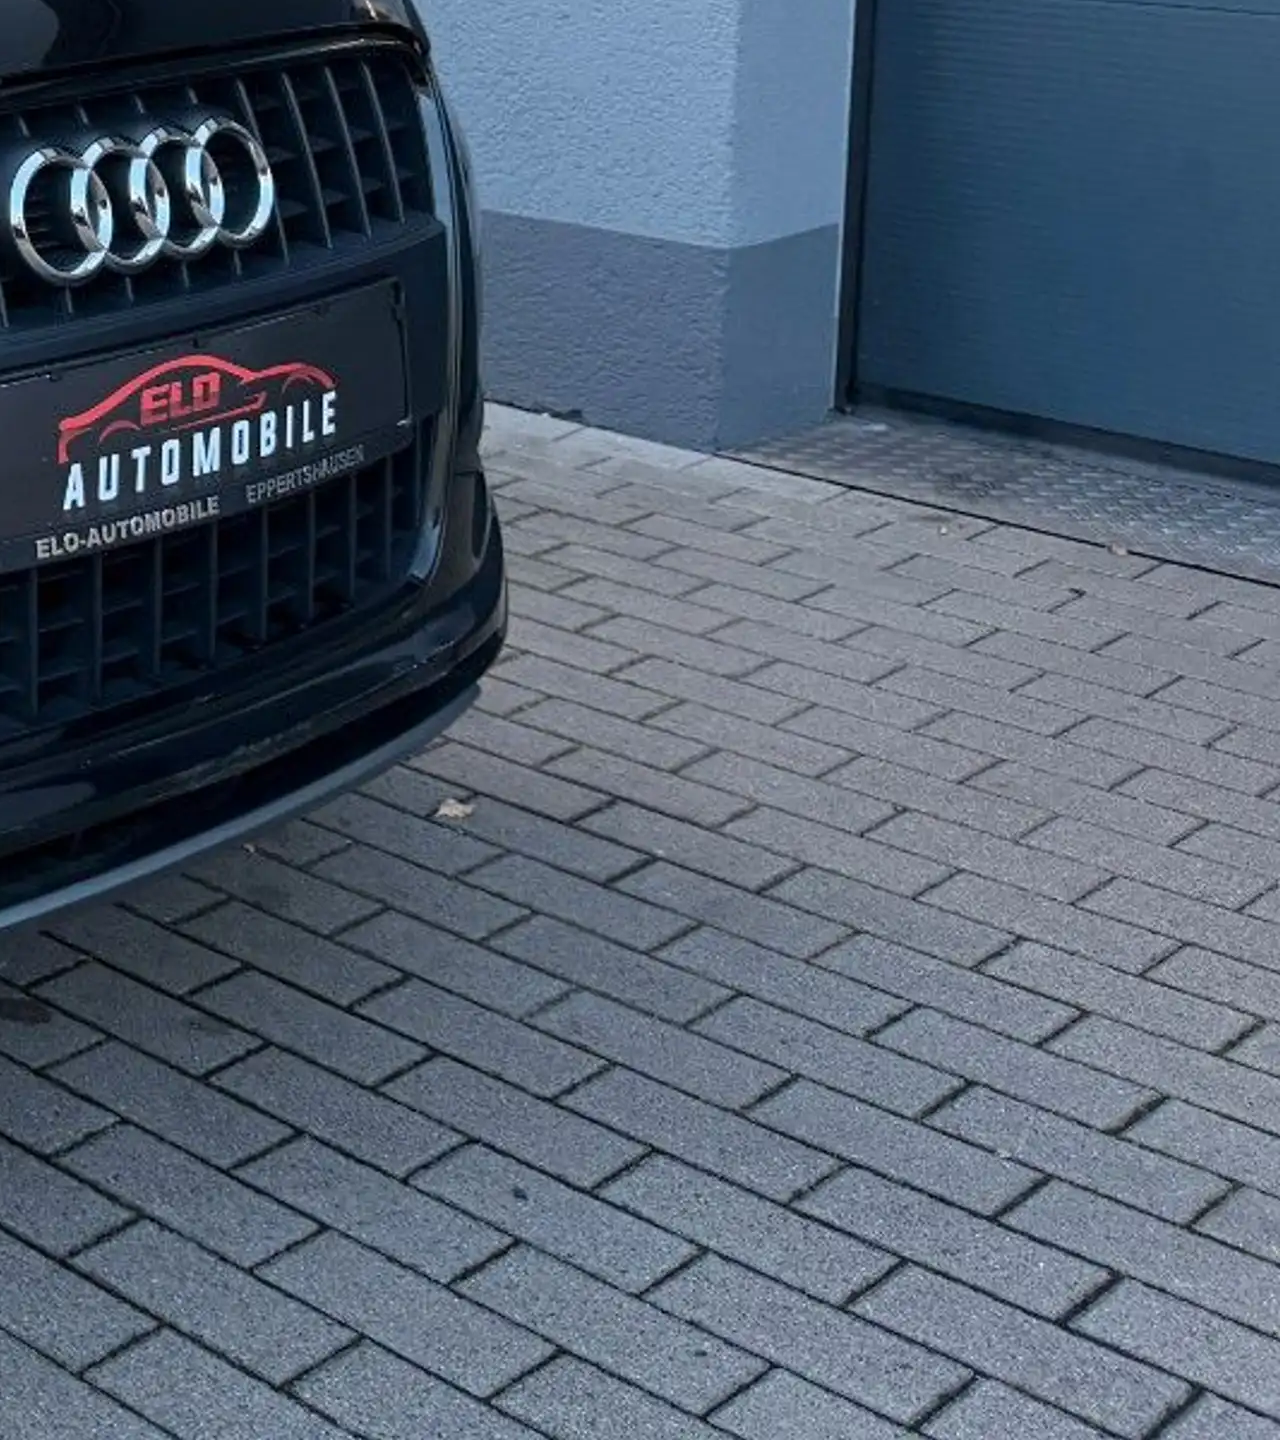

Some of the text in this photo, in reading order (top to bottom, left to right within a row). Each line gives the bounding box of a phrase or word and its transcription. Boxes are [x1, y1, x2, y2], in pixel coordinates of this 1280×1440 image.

[140, 372, 220, 426] ELO
[63, 390, 336, 511] AUTOMOBILE
[35, 495, 221, 560] ELO-AUTOMOBILE
